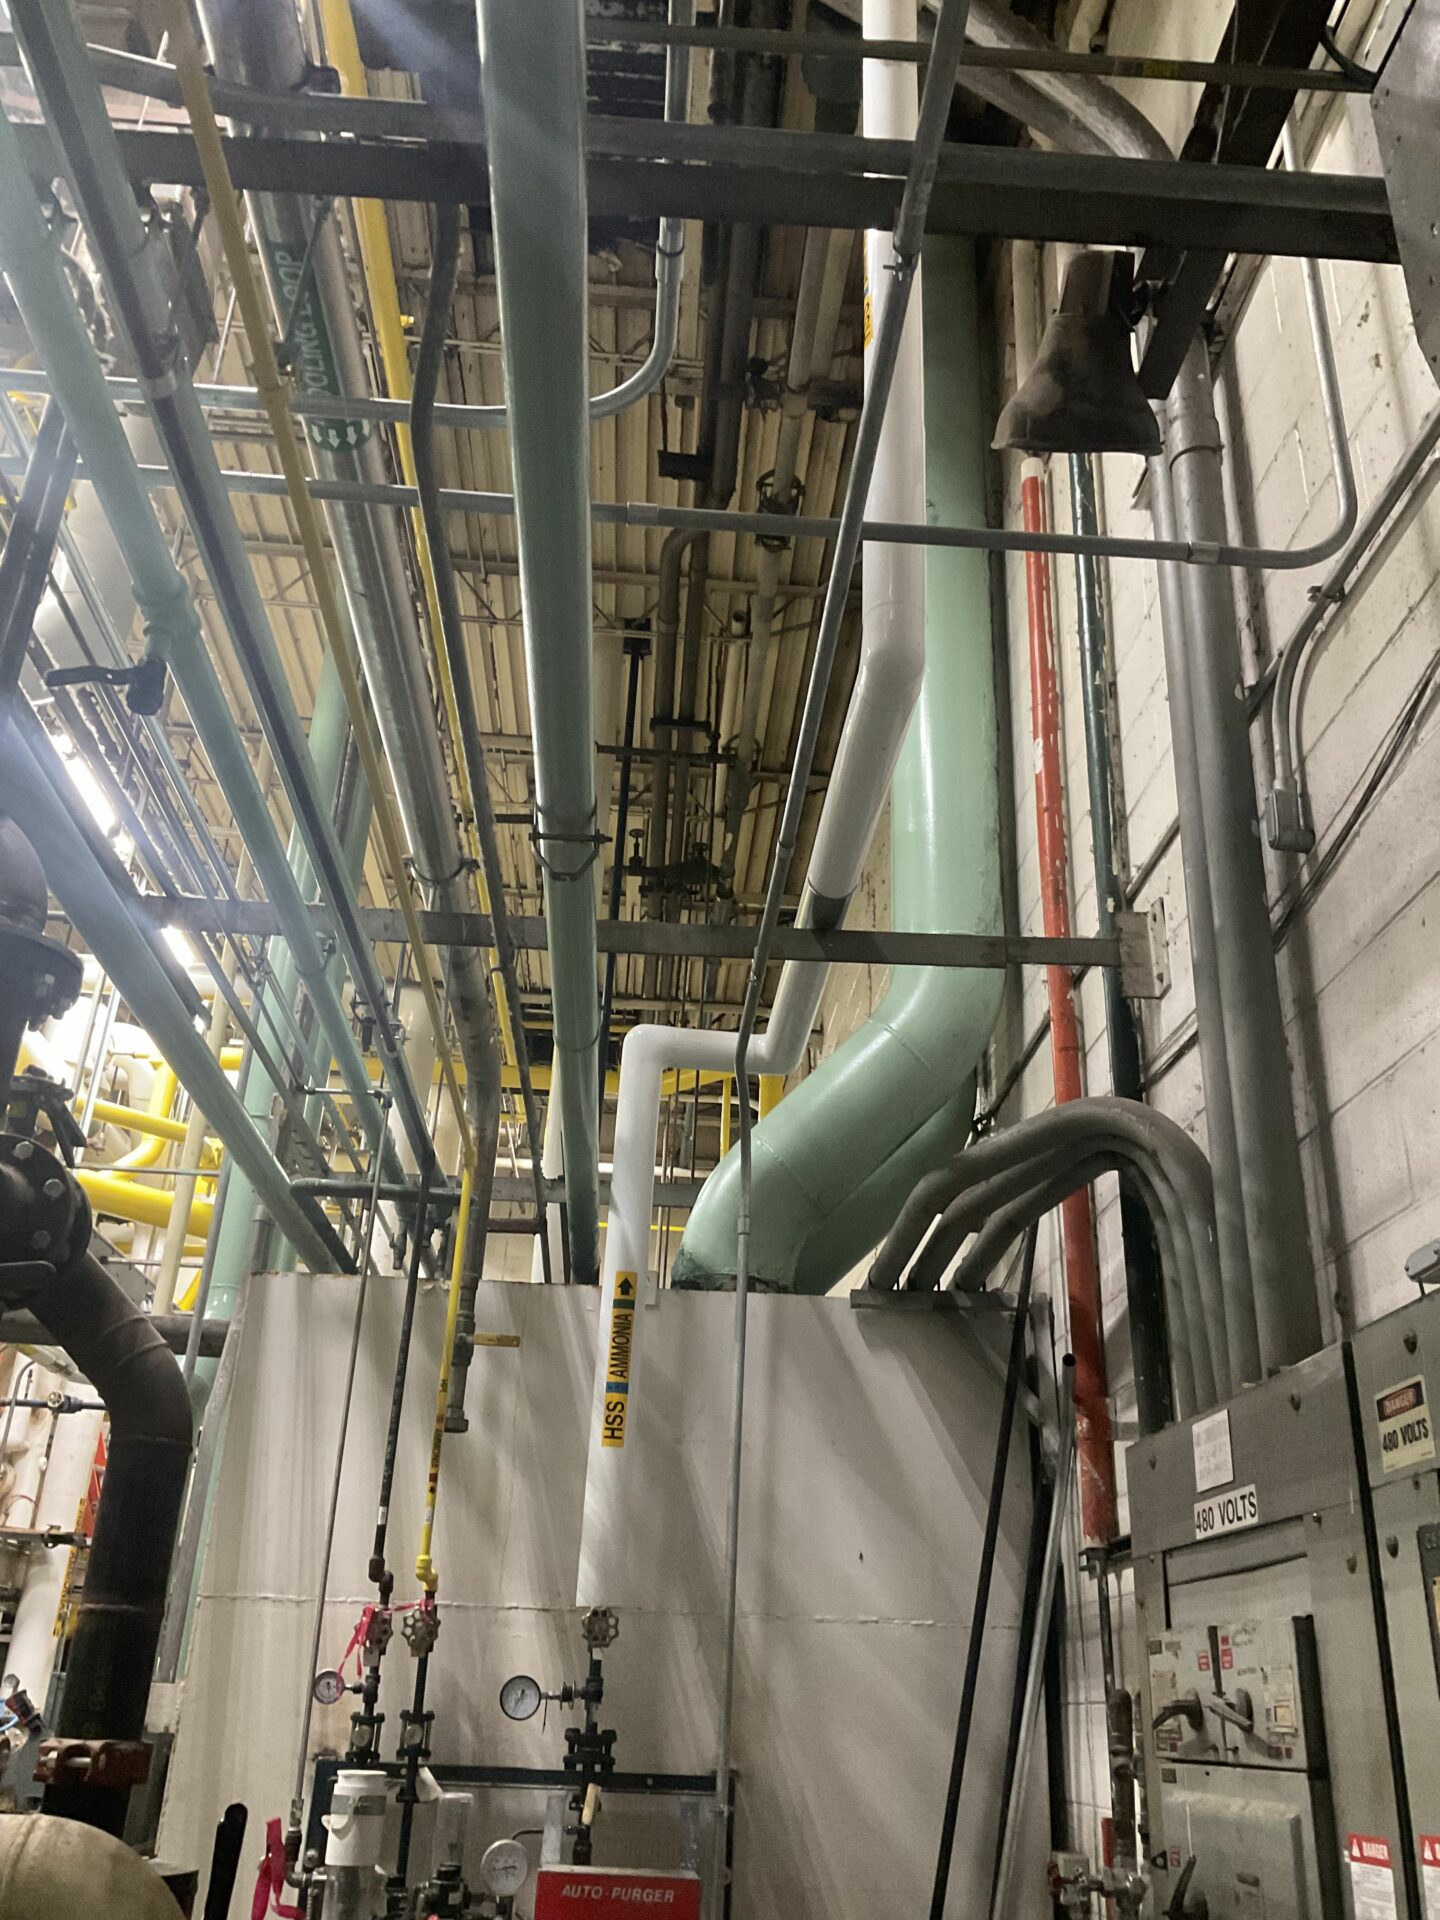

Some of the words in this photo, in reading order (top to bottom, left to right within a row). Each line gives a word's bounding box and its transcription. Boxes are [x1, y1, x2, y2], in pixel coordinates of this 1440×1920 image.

[296, 320, 332, 398] OLING
[609, 1313, 632, 1379] AMMONIA
[603, 1400, 625, 1440] HSS
[1383, 1429, 1399, 1453] 480
[1400, 1418, 1429, 1446] VOLTS
[1196, 1506, 1215, 1533] 480
[1218, 1492, 1257, 1526] VOLTS
